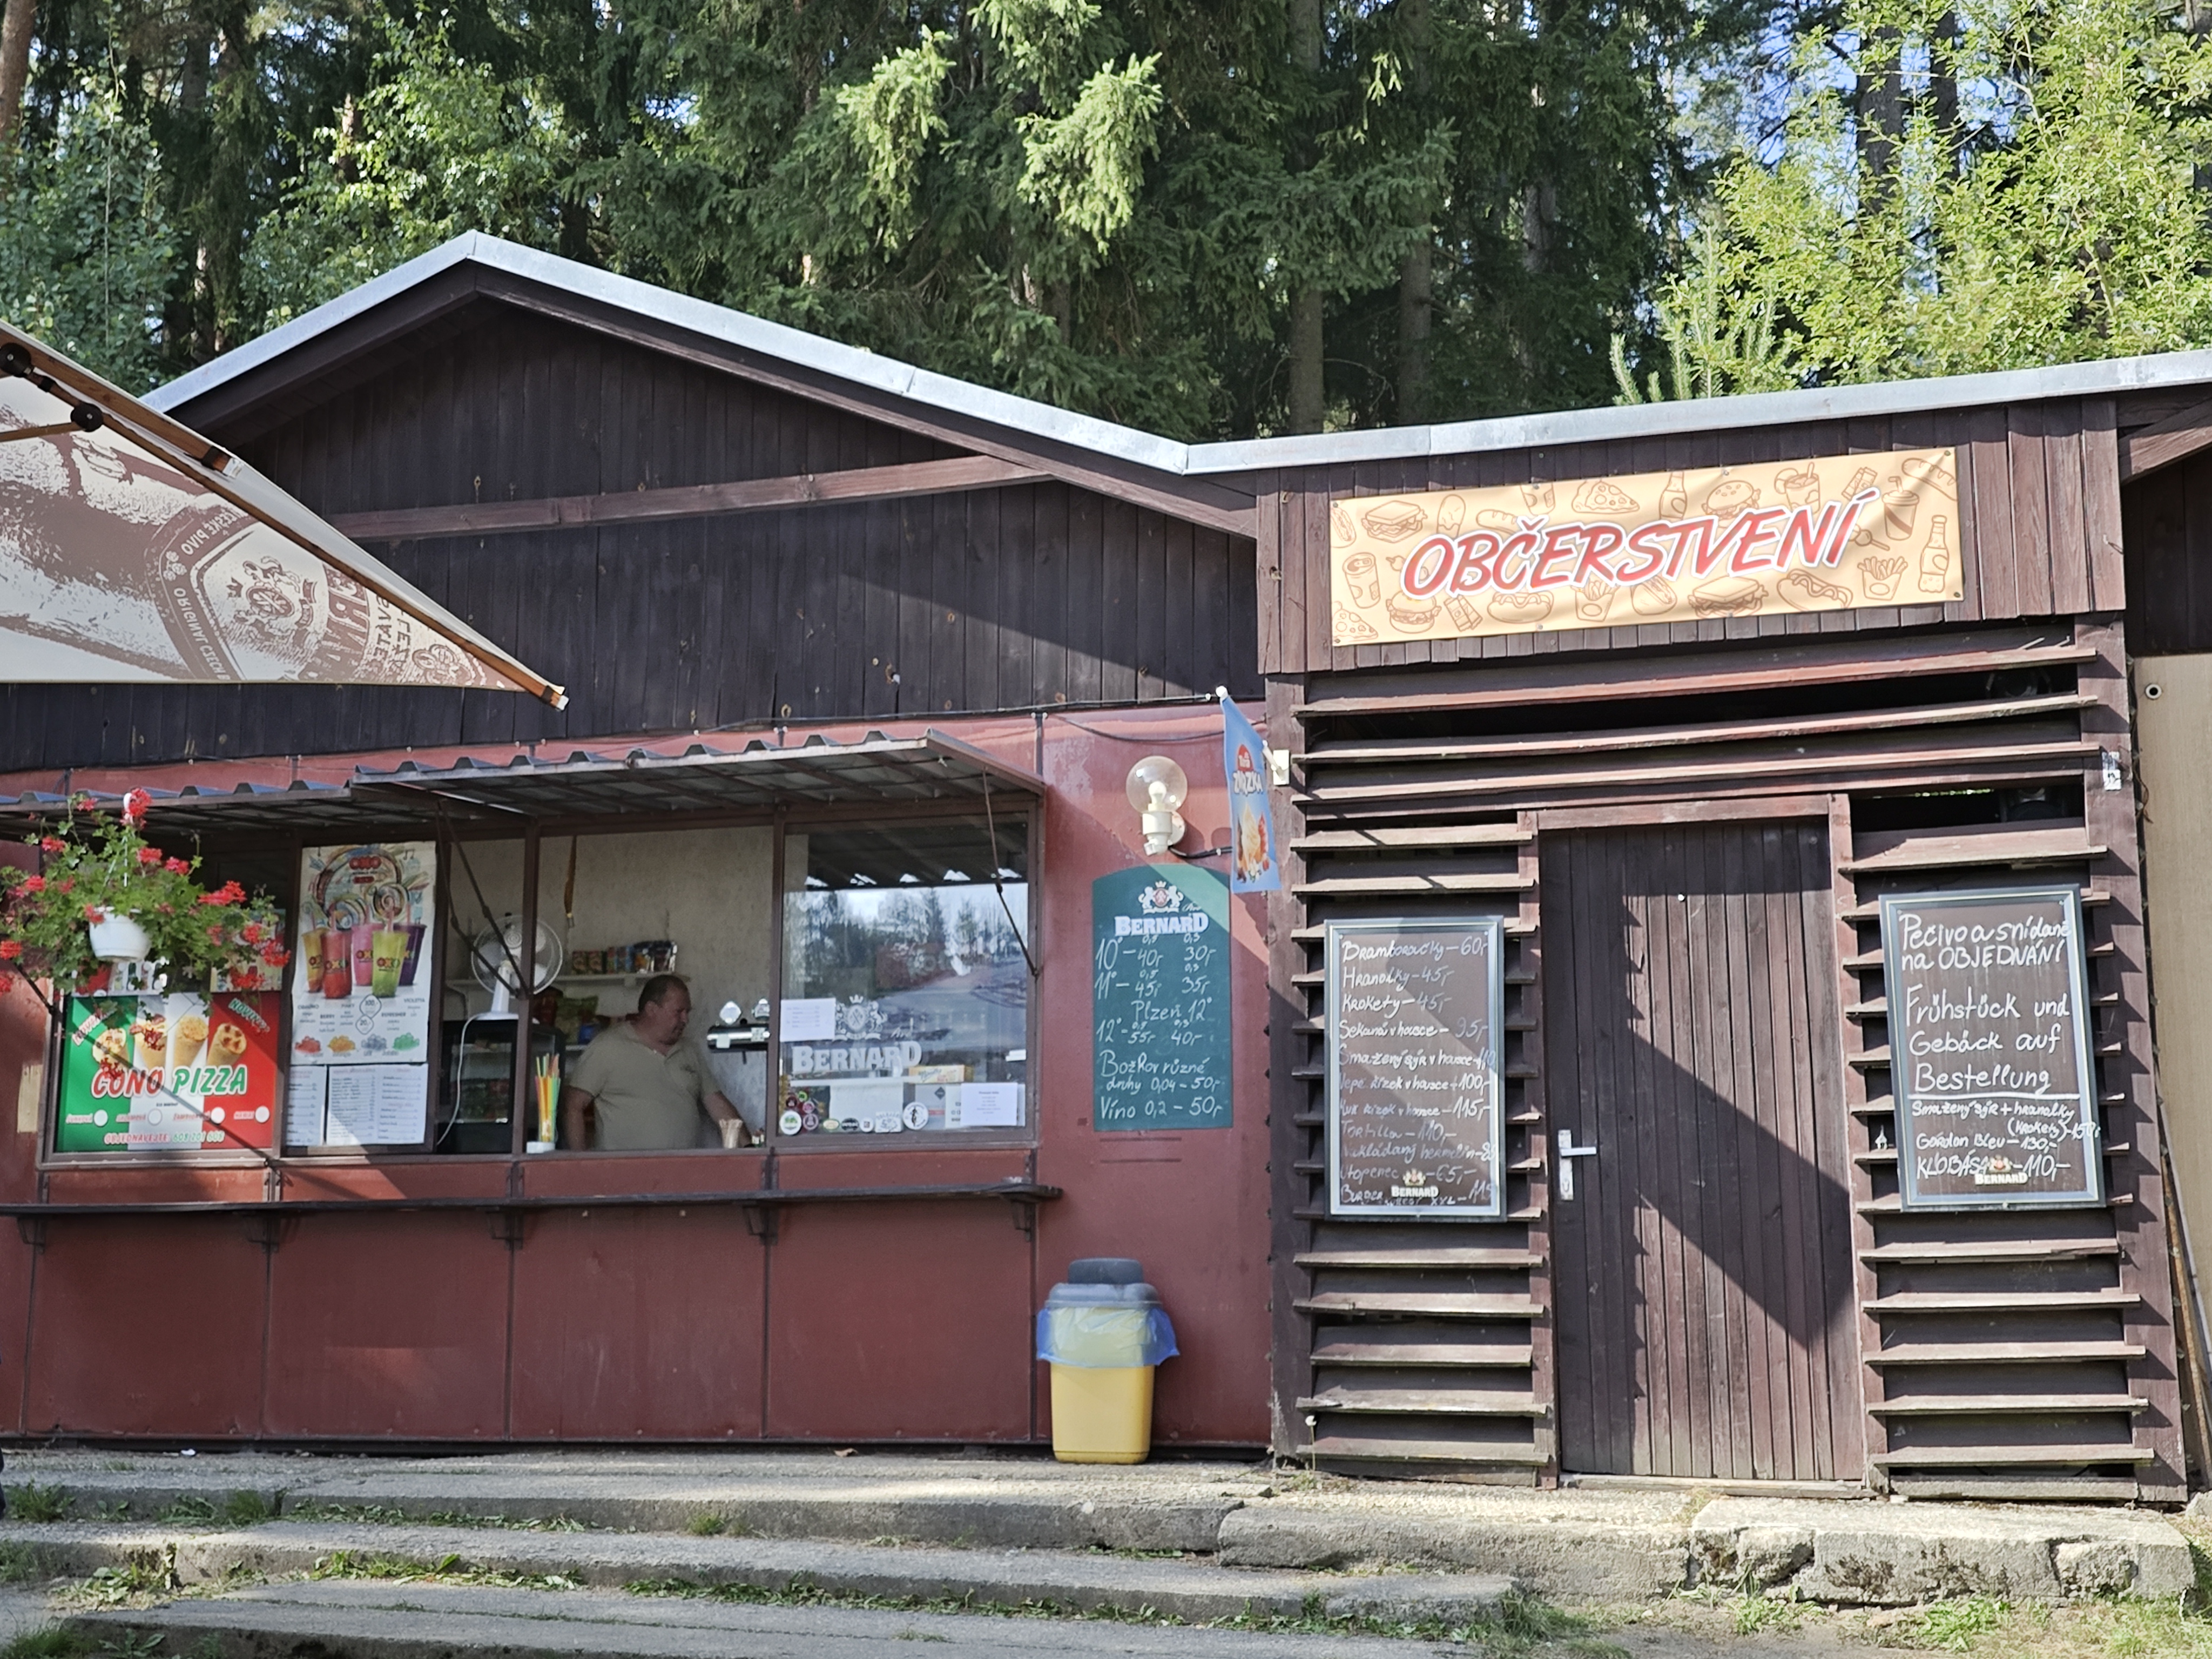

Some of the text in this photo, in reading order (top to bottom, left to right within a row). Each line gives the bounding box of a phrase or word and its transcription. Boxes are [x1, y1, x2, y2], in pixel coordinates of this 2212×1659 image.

[1400, 486, 1880, 599] OBČERSTVENÍ
[1114, 912, 1209, 936] BERNARD
[1899, 913, 1968, 951] Pečivo
[1995, 915, 2071, 942] snídaně
[1901, 939, 2066, 971] na OBJEDNÁNÍ
[1131, 1000, 1182, 1022] Plzeň
[1905, 983, 2071, 1027] Frühstück und
[1909, 1022, 2062, 1056] Gebäck auf
[792, 1041, 922, 1074] BERNARD
[91, 1064, 248, 1098] CONO PIZZA
[1107, 1074, 1141, 1095] druhy
[1914, 1062, 2052, 1095] Bestellung
[1101, 1096, 1136, 1120] Víno
[1145, 1100, 1167, 1119] 0,2
[1391, 1185, 1439, 1198] BERNARD
[1974, 1172, 2029, 1186] BERNARD
